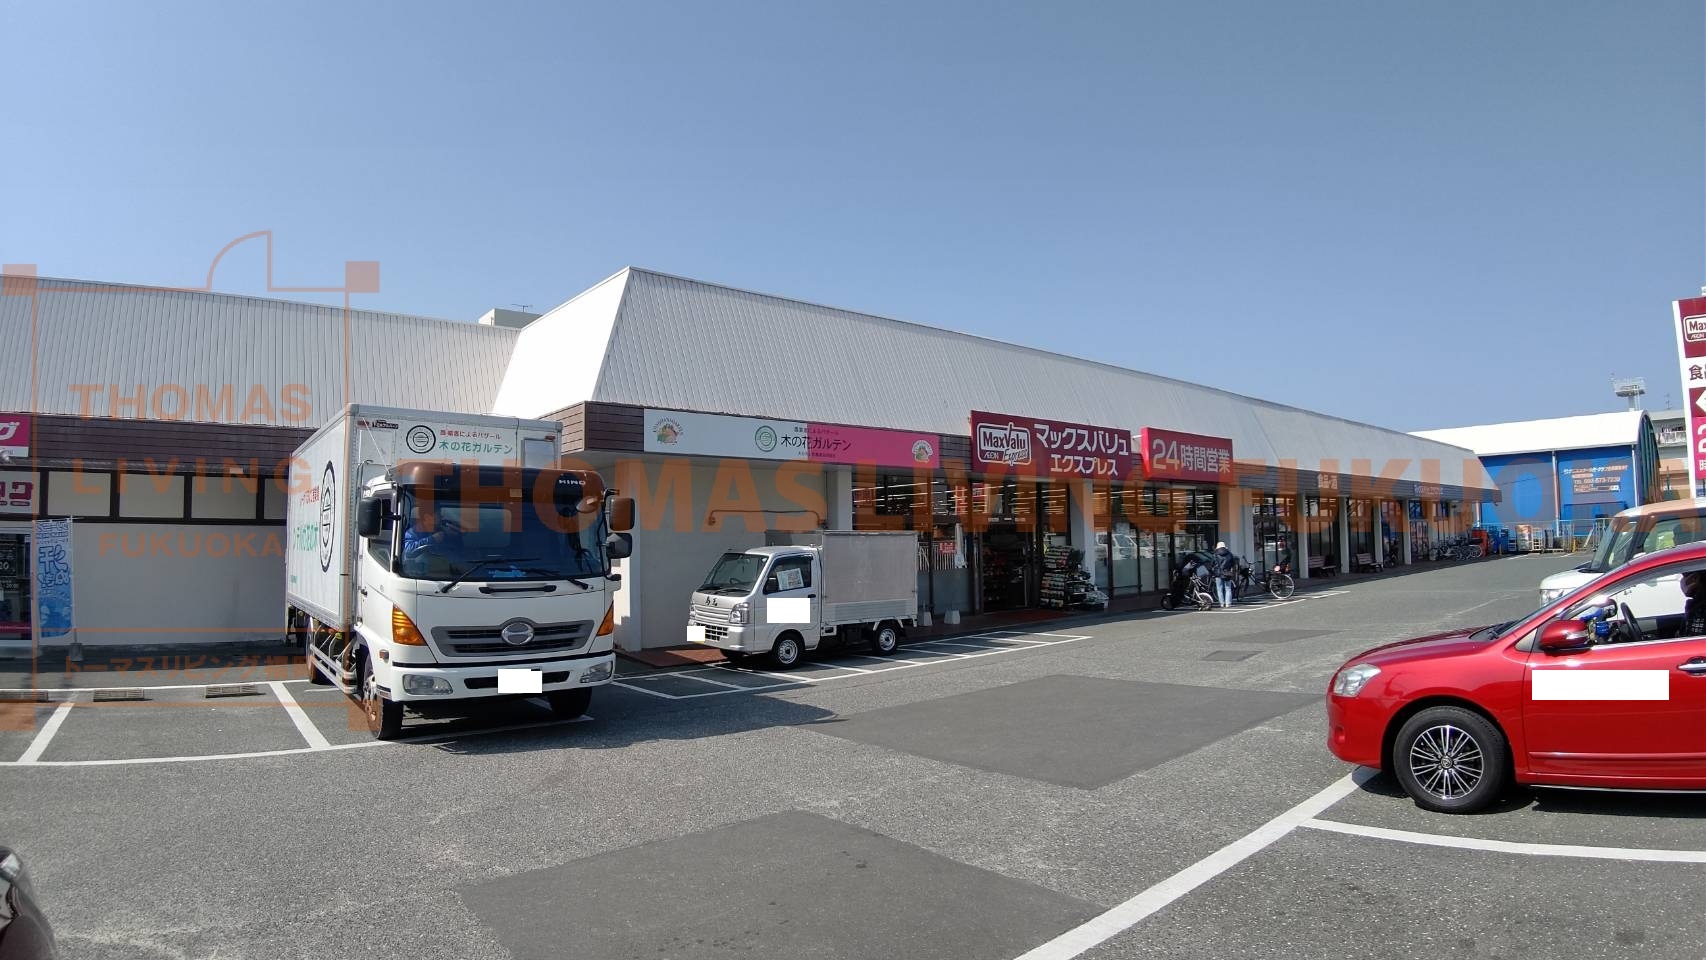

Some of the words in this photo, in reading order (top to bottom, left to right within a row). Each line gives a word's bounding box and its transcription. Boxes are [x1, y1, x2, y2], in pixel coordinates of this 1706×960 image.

[1688, 364, 1706, 380] 食
[439, 440, 513, 454] 木の花ガルテン
[781, 434, 852, 451] 木の花ガルテン
[983, 422, 1026, 450] MaxValu
[1034, 423, 1129, 456] マックスバリュ
[1050, 453, 1119, 476] エクスプレス
[1152, 438, 1231, 473] 24時間営業
